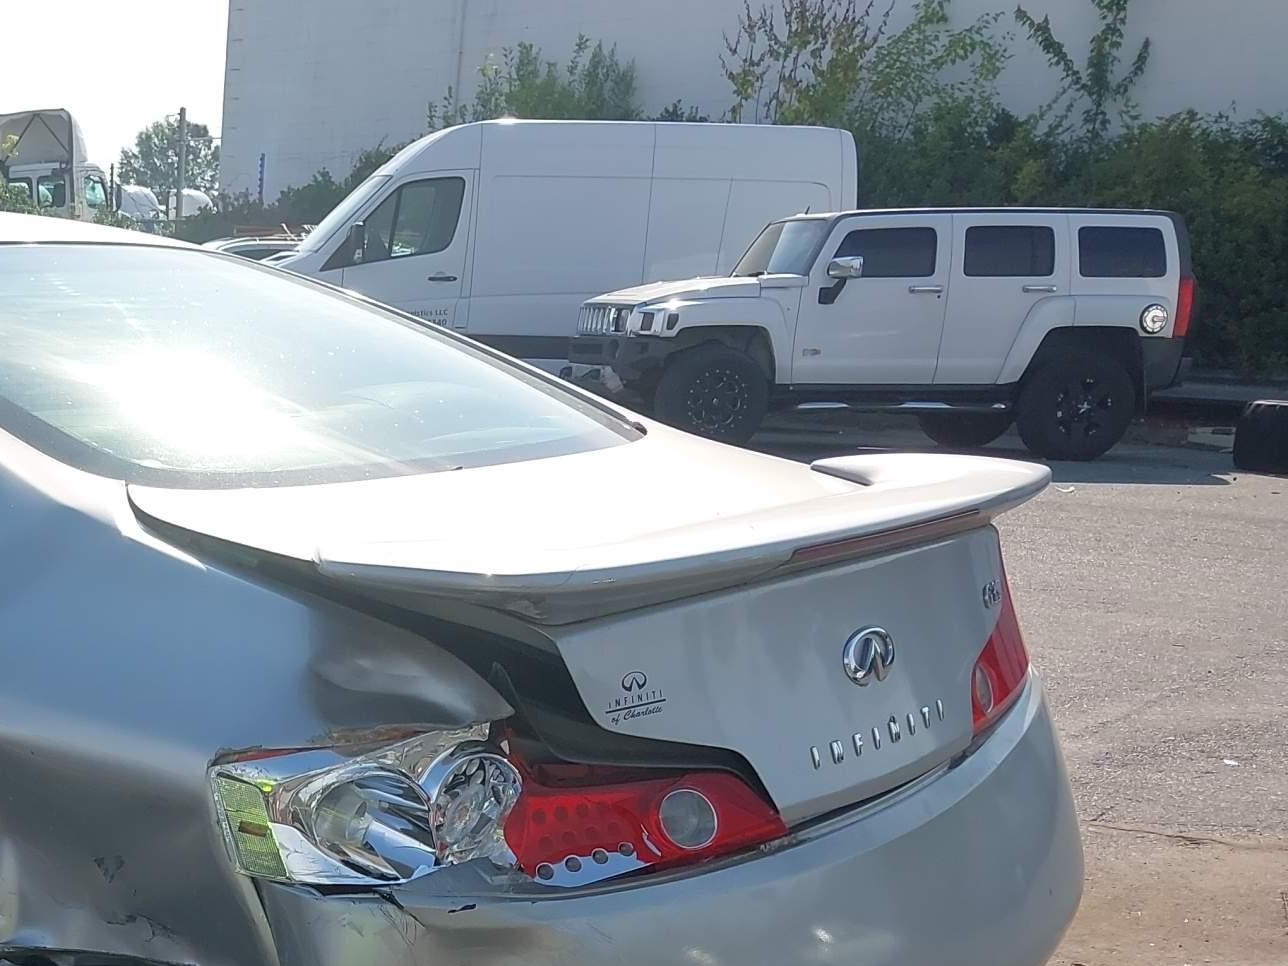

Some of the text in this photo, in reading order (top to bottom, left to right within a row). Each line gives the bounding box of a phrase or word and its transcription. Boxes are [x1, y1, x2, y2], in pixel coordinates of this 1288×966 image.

[435, 308, 448, 316] LLC
[608, 689, 663, 709] INFINITI
[611, 705, 663, 726] of Charlotte
[810, 699, 945, 770] INFINITI
